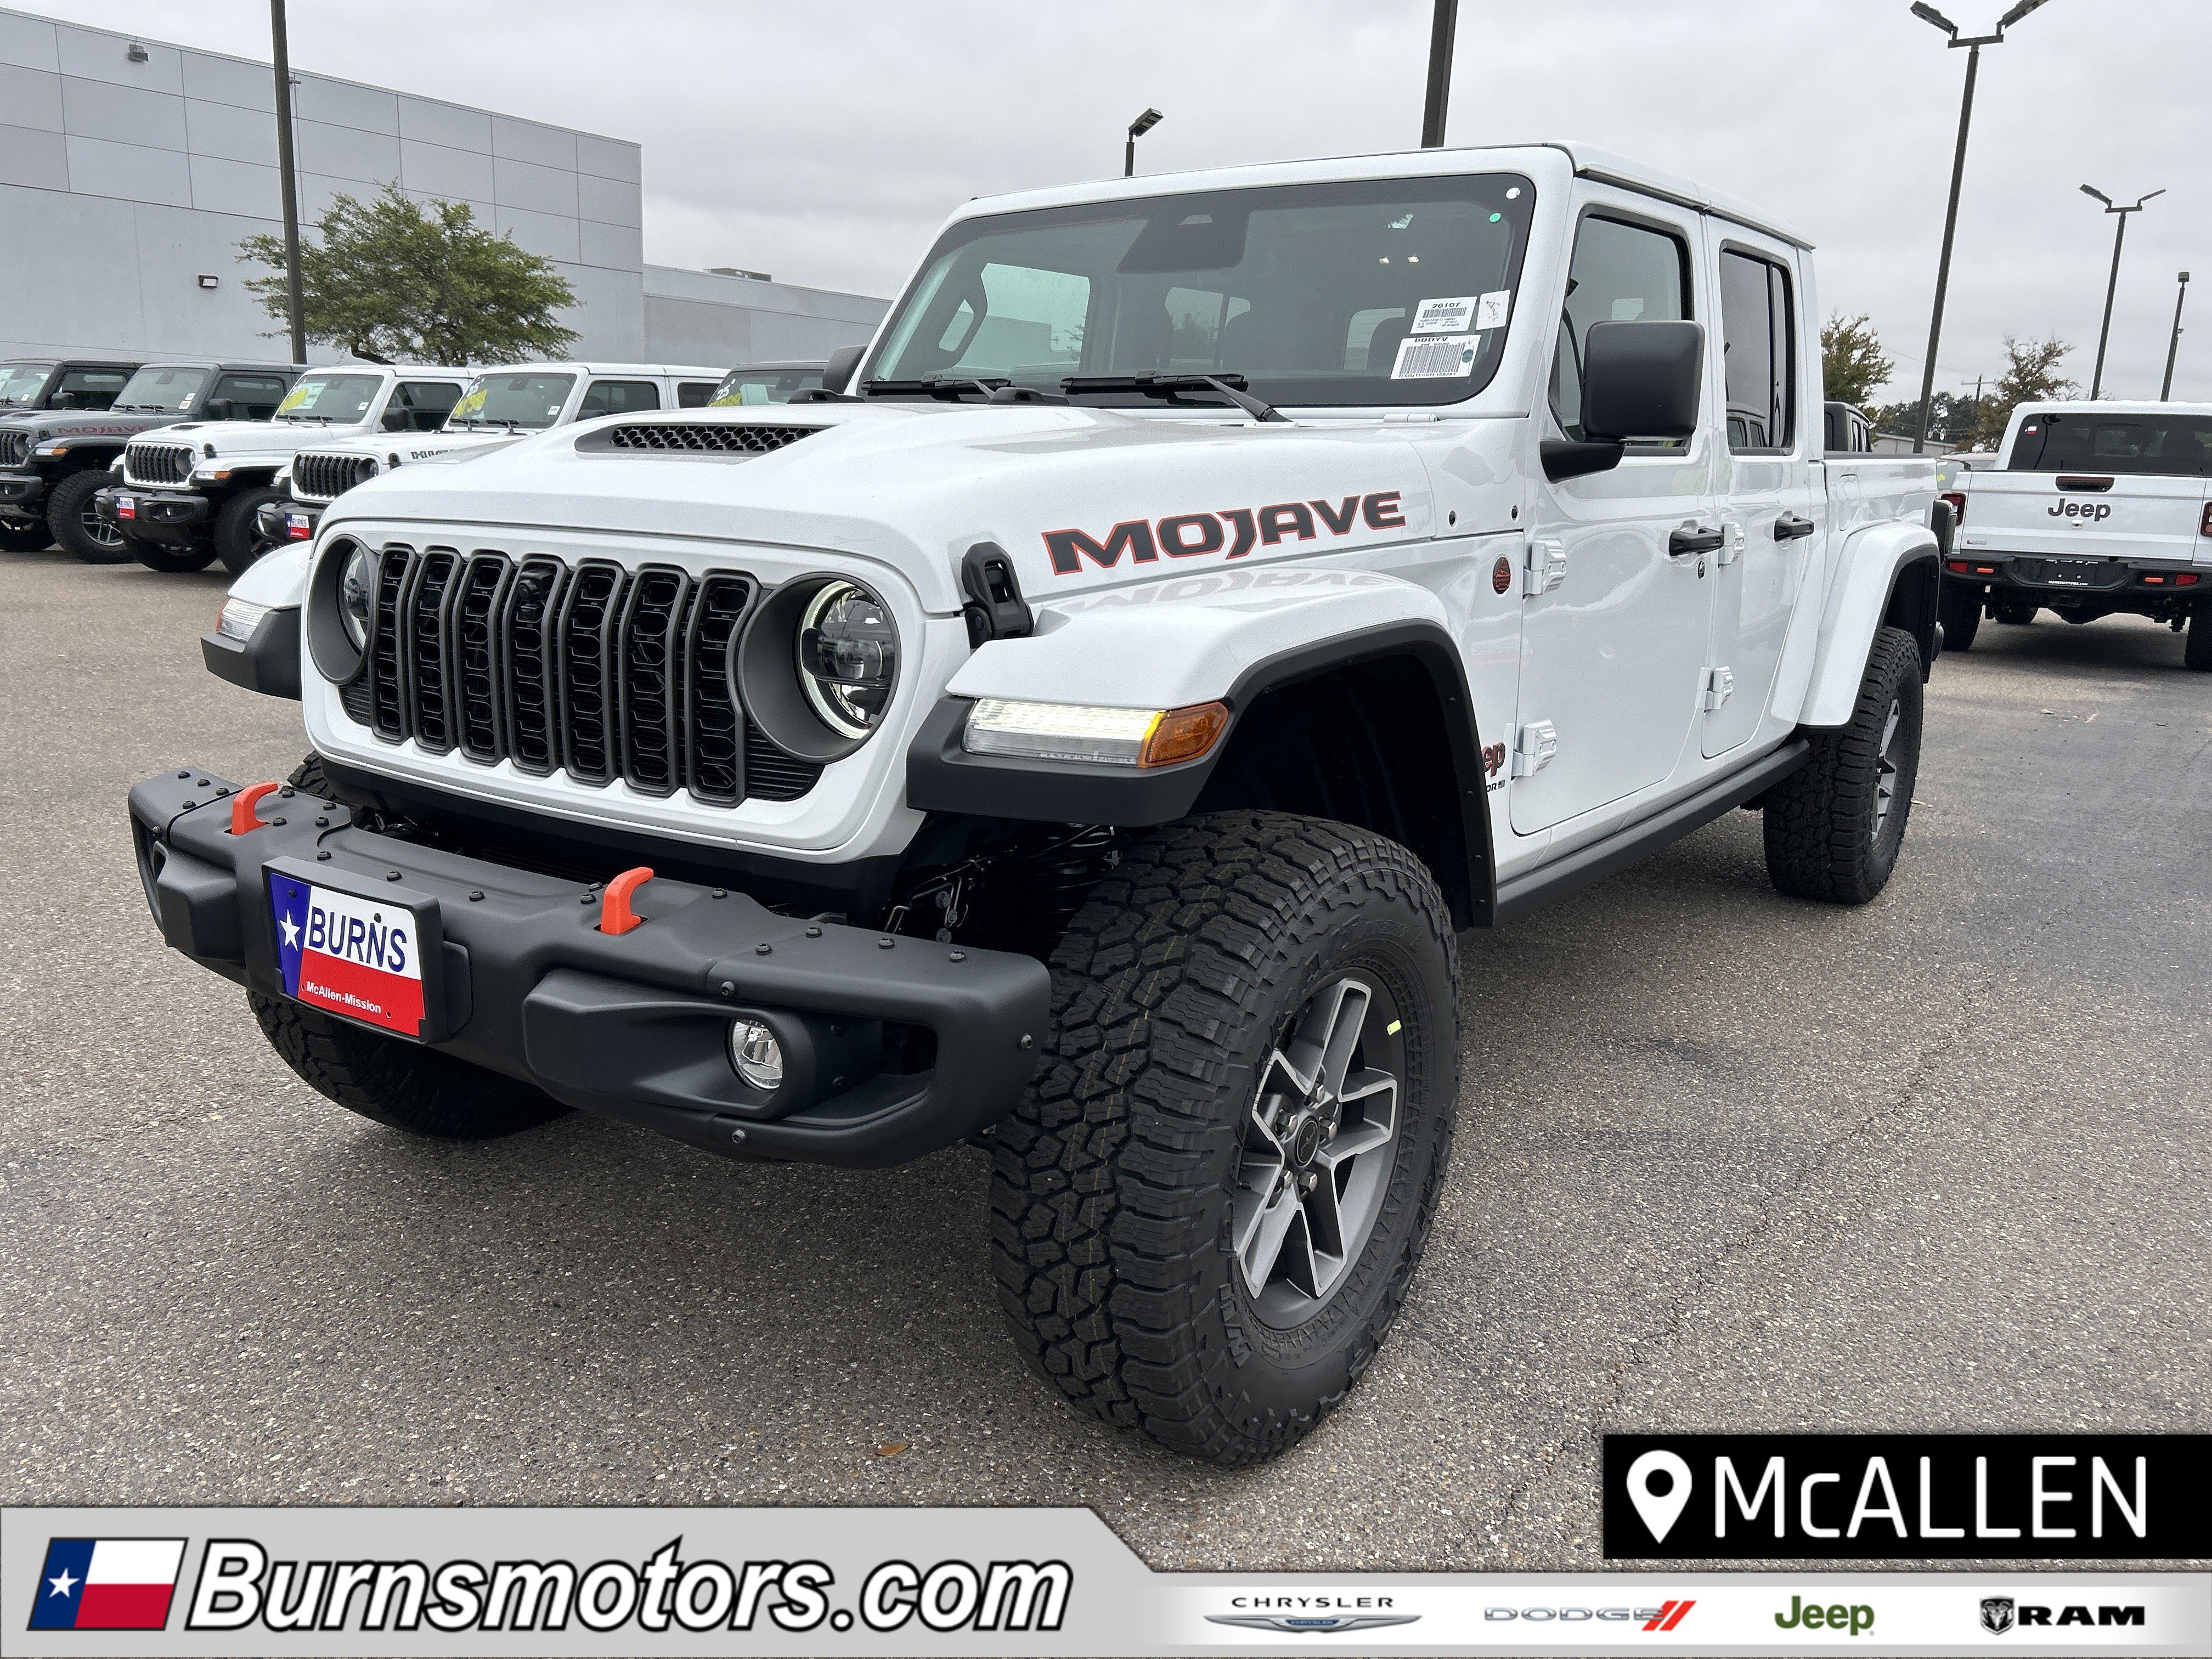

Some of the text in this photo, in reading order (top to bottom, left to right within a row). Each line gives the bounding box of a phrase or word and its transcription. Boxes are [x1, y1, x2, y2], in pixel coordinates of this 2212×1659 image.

[2047, 498, 2112, 522] Jeep
[1041, 490, 1406, 576] MOJAVE
[1481, 741, 1506, 777] ep
[308, 906, 407, 972] BURNS
[306, 980, 382, 1014] McAllen-Mission
